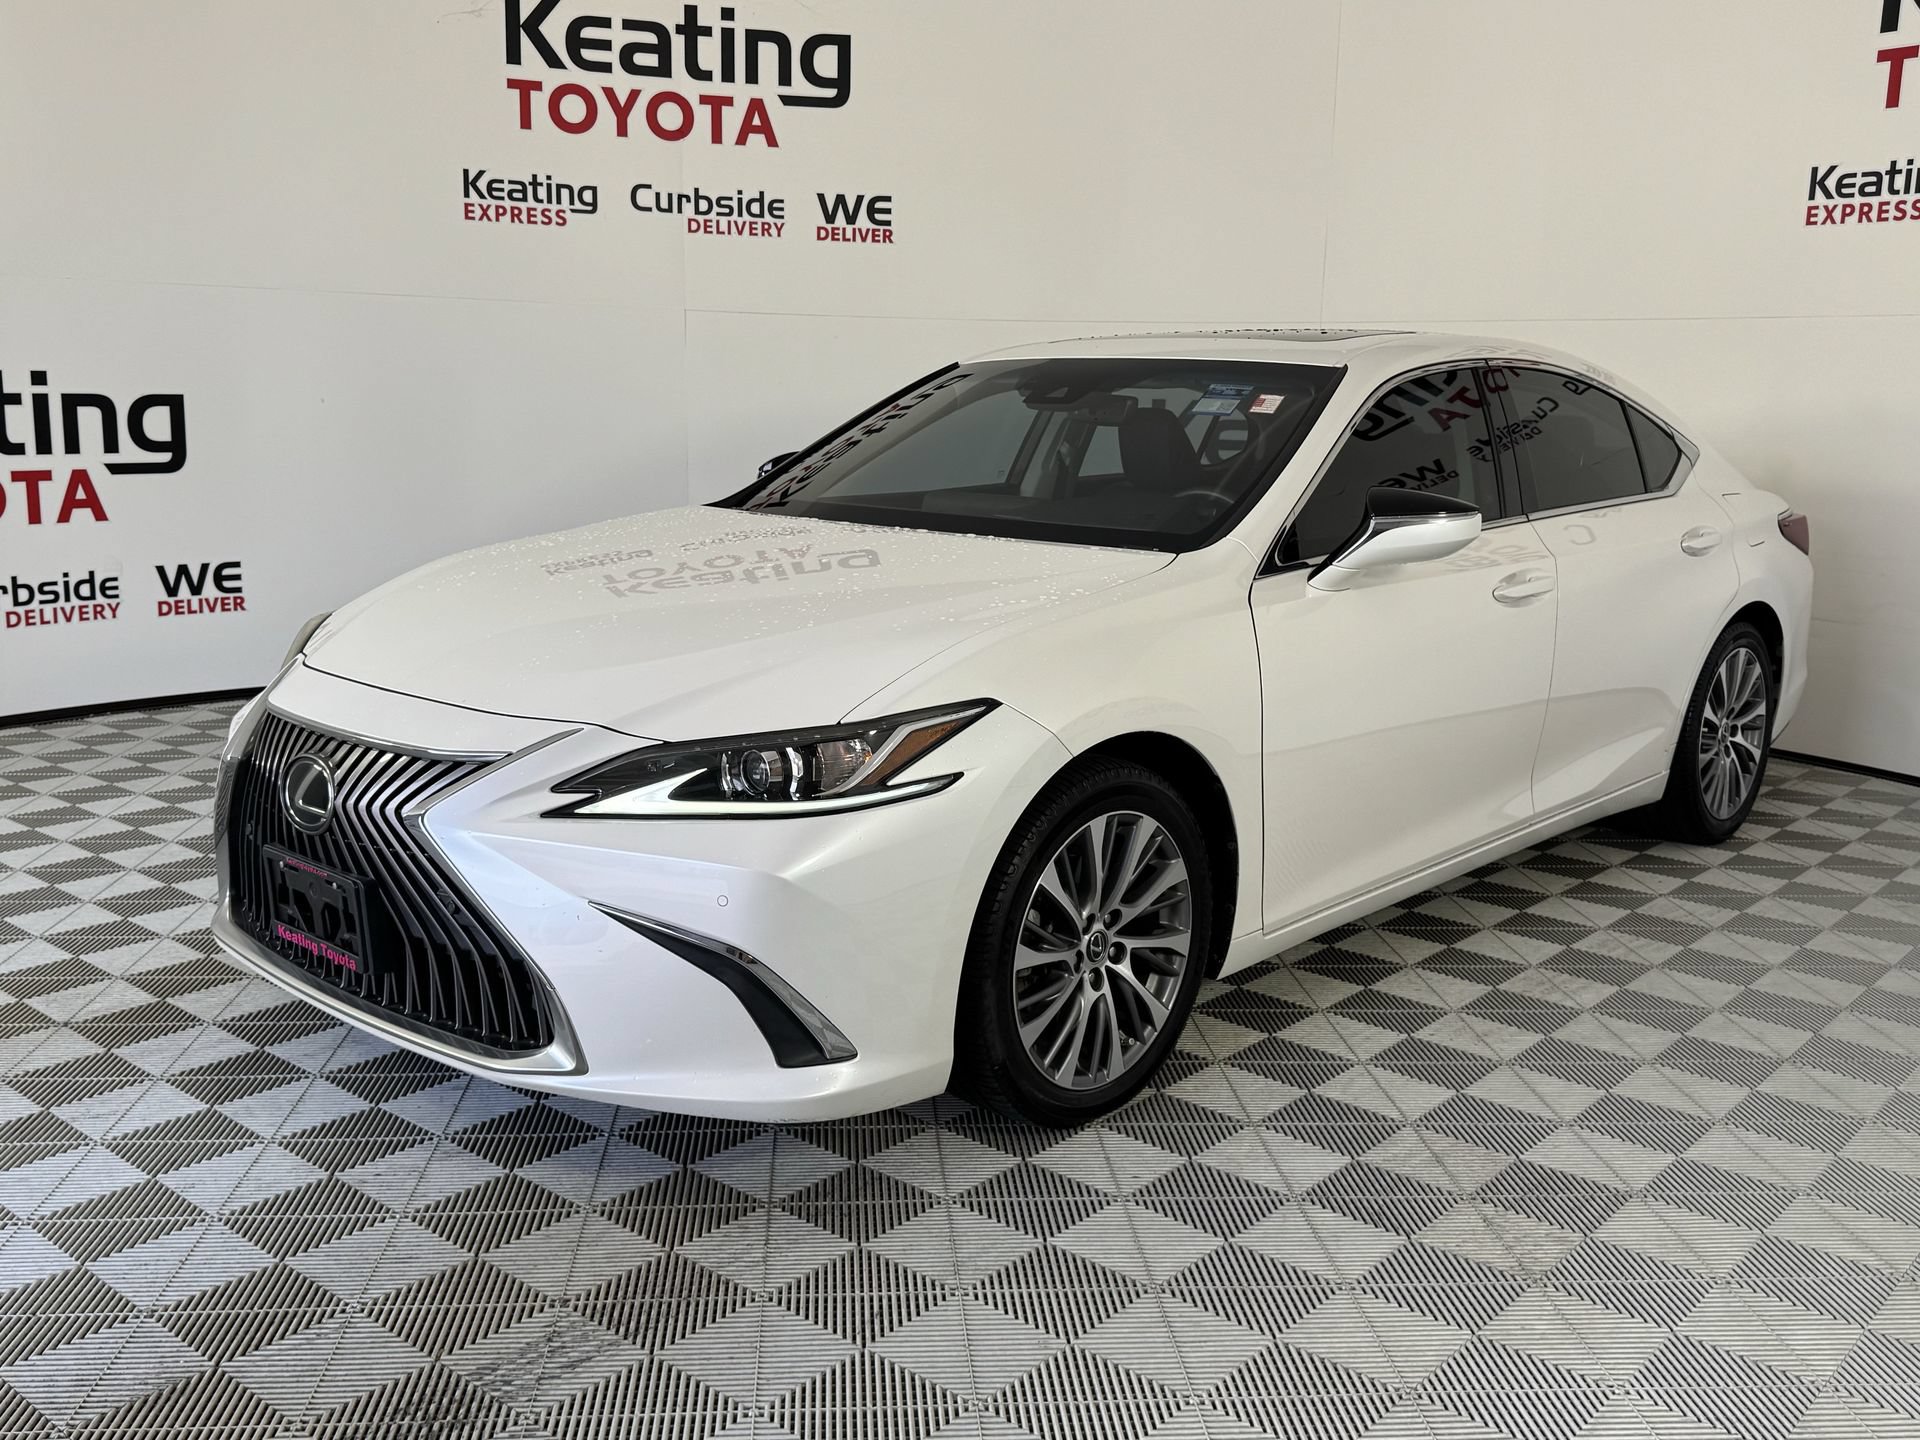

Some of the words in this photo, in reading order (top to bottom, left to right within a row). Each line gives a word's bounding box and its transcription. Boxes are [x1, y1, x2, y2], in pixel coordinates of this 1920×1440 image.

[505, 0, 851, 108] Keating
[507, 78, 780, 148] TOYOTA
[463, 169, 598, 214] Keating
[1808, 159, 1920, 201] Keati
[464, 203, 567, 227] EXPRESS
[630, 183, 785, 219] Curbside
[687, 218, 785, 238] DELIVERY
[816, 226, 894, 244] DELIVER
[5, 602, 121, 629] DELIVERY
[157, 596, 247, 617] DELIVER
[277, 924, 319, 955] Keating
[320, 943, 357, 972] Toyota
